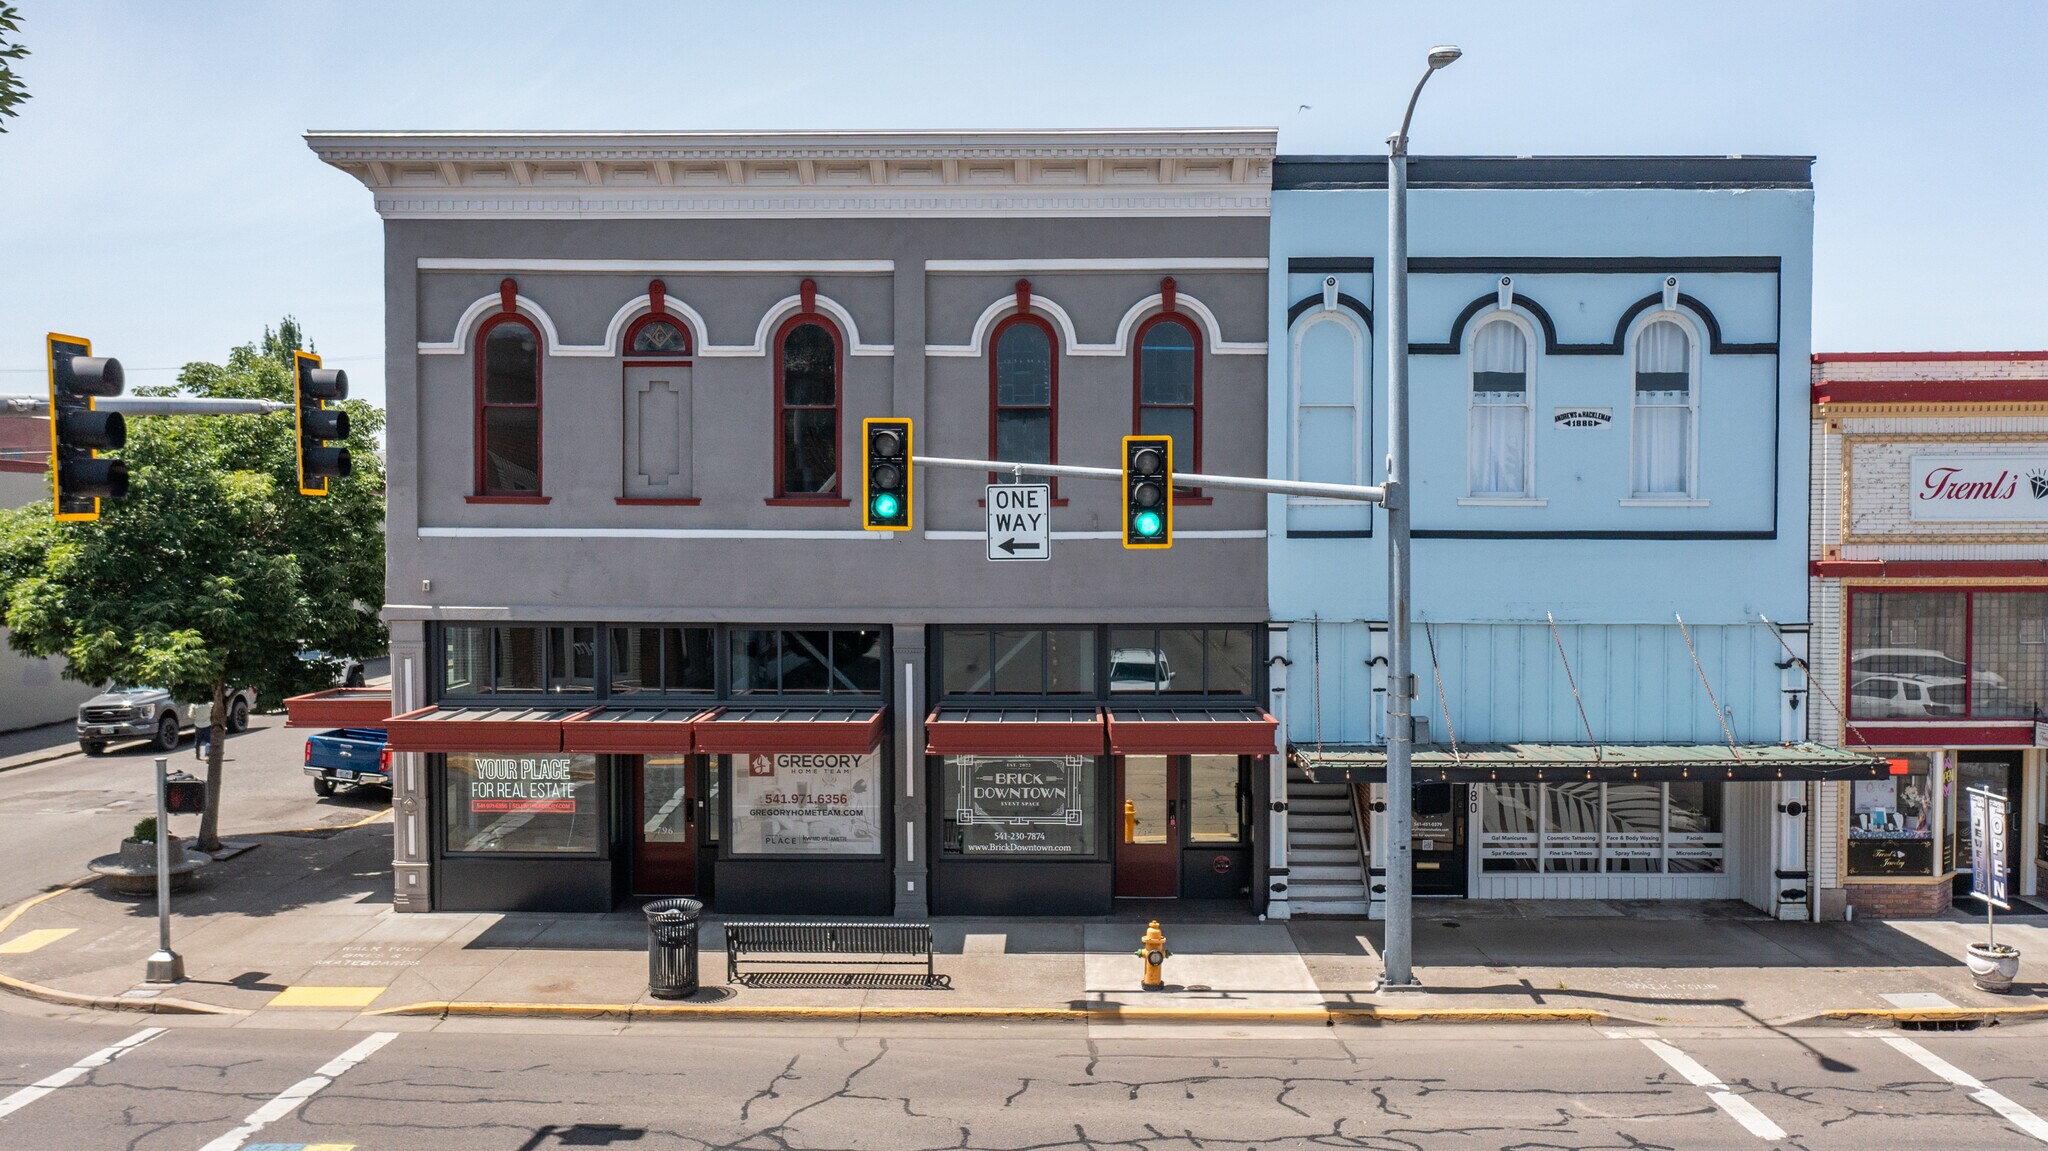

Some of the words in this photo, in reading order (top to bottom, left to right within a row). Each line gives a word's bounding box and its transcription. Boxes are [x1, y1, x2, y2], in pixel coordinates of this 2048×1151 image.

[1555, 411, 1578, 422] ANDREWS
[1582, 411, 1611, 422] HACKLEMAN
[1572, 419, 1593, 427] 1886
[1919, 467, 2018, 501] Treml's
[996, 490, 1039, 509] ONE
[996, 513, 1042, 532] WAY
[777, 754, 862, 768] GREGORY
[475, 759, 518, 780] YOUR
[520, 759, 571, 780] PLACE
[995, 773, 1044, 785] BRICK
[471, 782, 494, 798] FOR
[497, 782, 527, 798] REAL
[530, 782, 575, 798] ESTATE
[973, 787, 1067, 799] DOWNTOWN
[765, 794, 848, 805] 541.971.6356
[749, 808, 864, 817] GREGORYHOMETEAM.COM
[657, 826, 673, 835] 796
[994, 832, 1045, 840] 541-230-7874
[765, 837, 797, 845] PLACE
[968, 843, 1072, 852] www.BrickDowntown.com
[1973, 818, 1986, 893] JEWELER
[1991, 816, 2006, 900] OPEN
